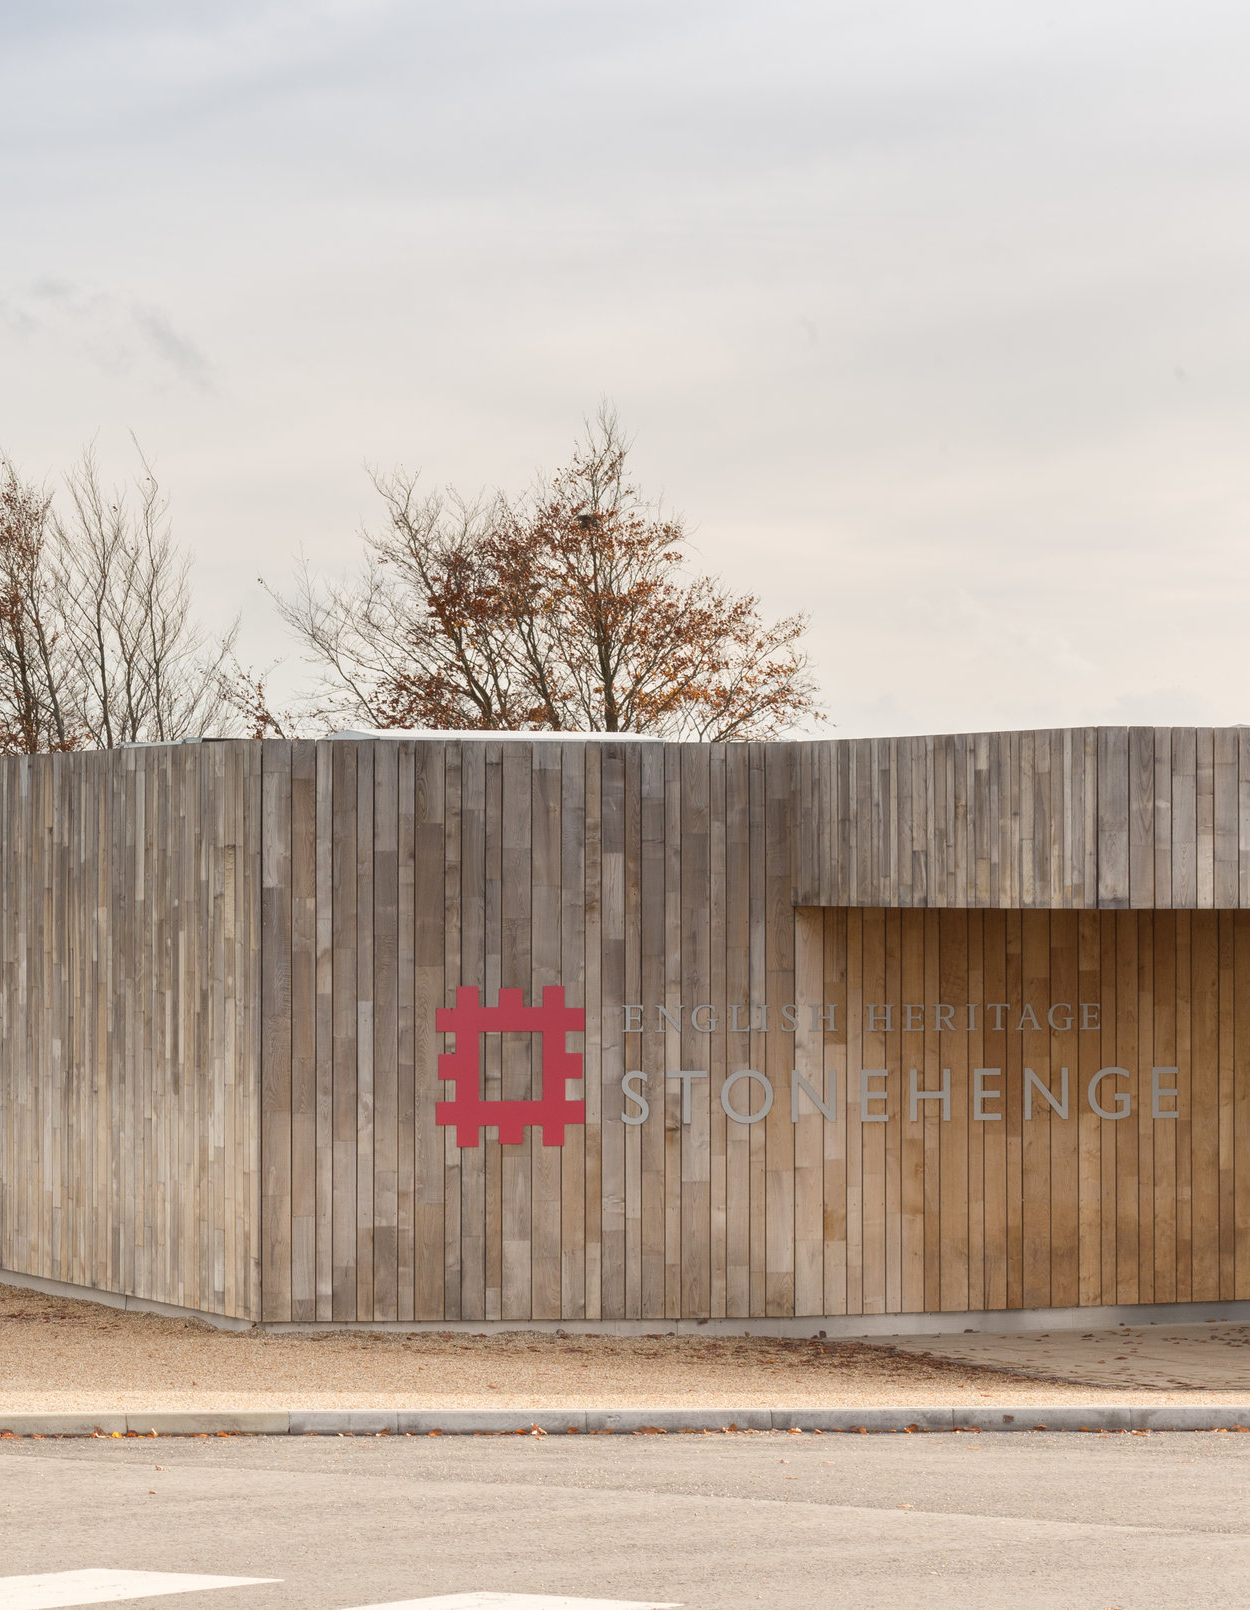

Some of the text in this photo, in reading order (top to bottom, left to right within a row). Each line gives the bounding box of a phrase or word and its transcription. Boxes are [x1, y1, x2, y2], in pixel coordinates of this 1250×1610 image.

[621, 1002, 1101, 1033] ENGLISH HERITAGE
[620, 1066, 1180, 1125] STONEHENGE
